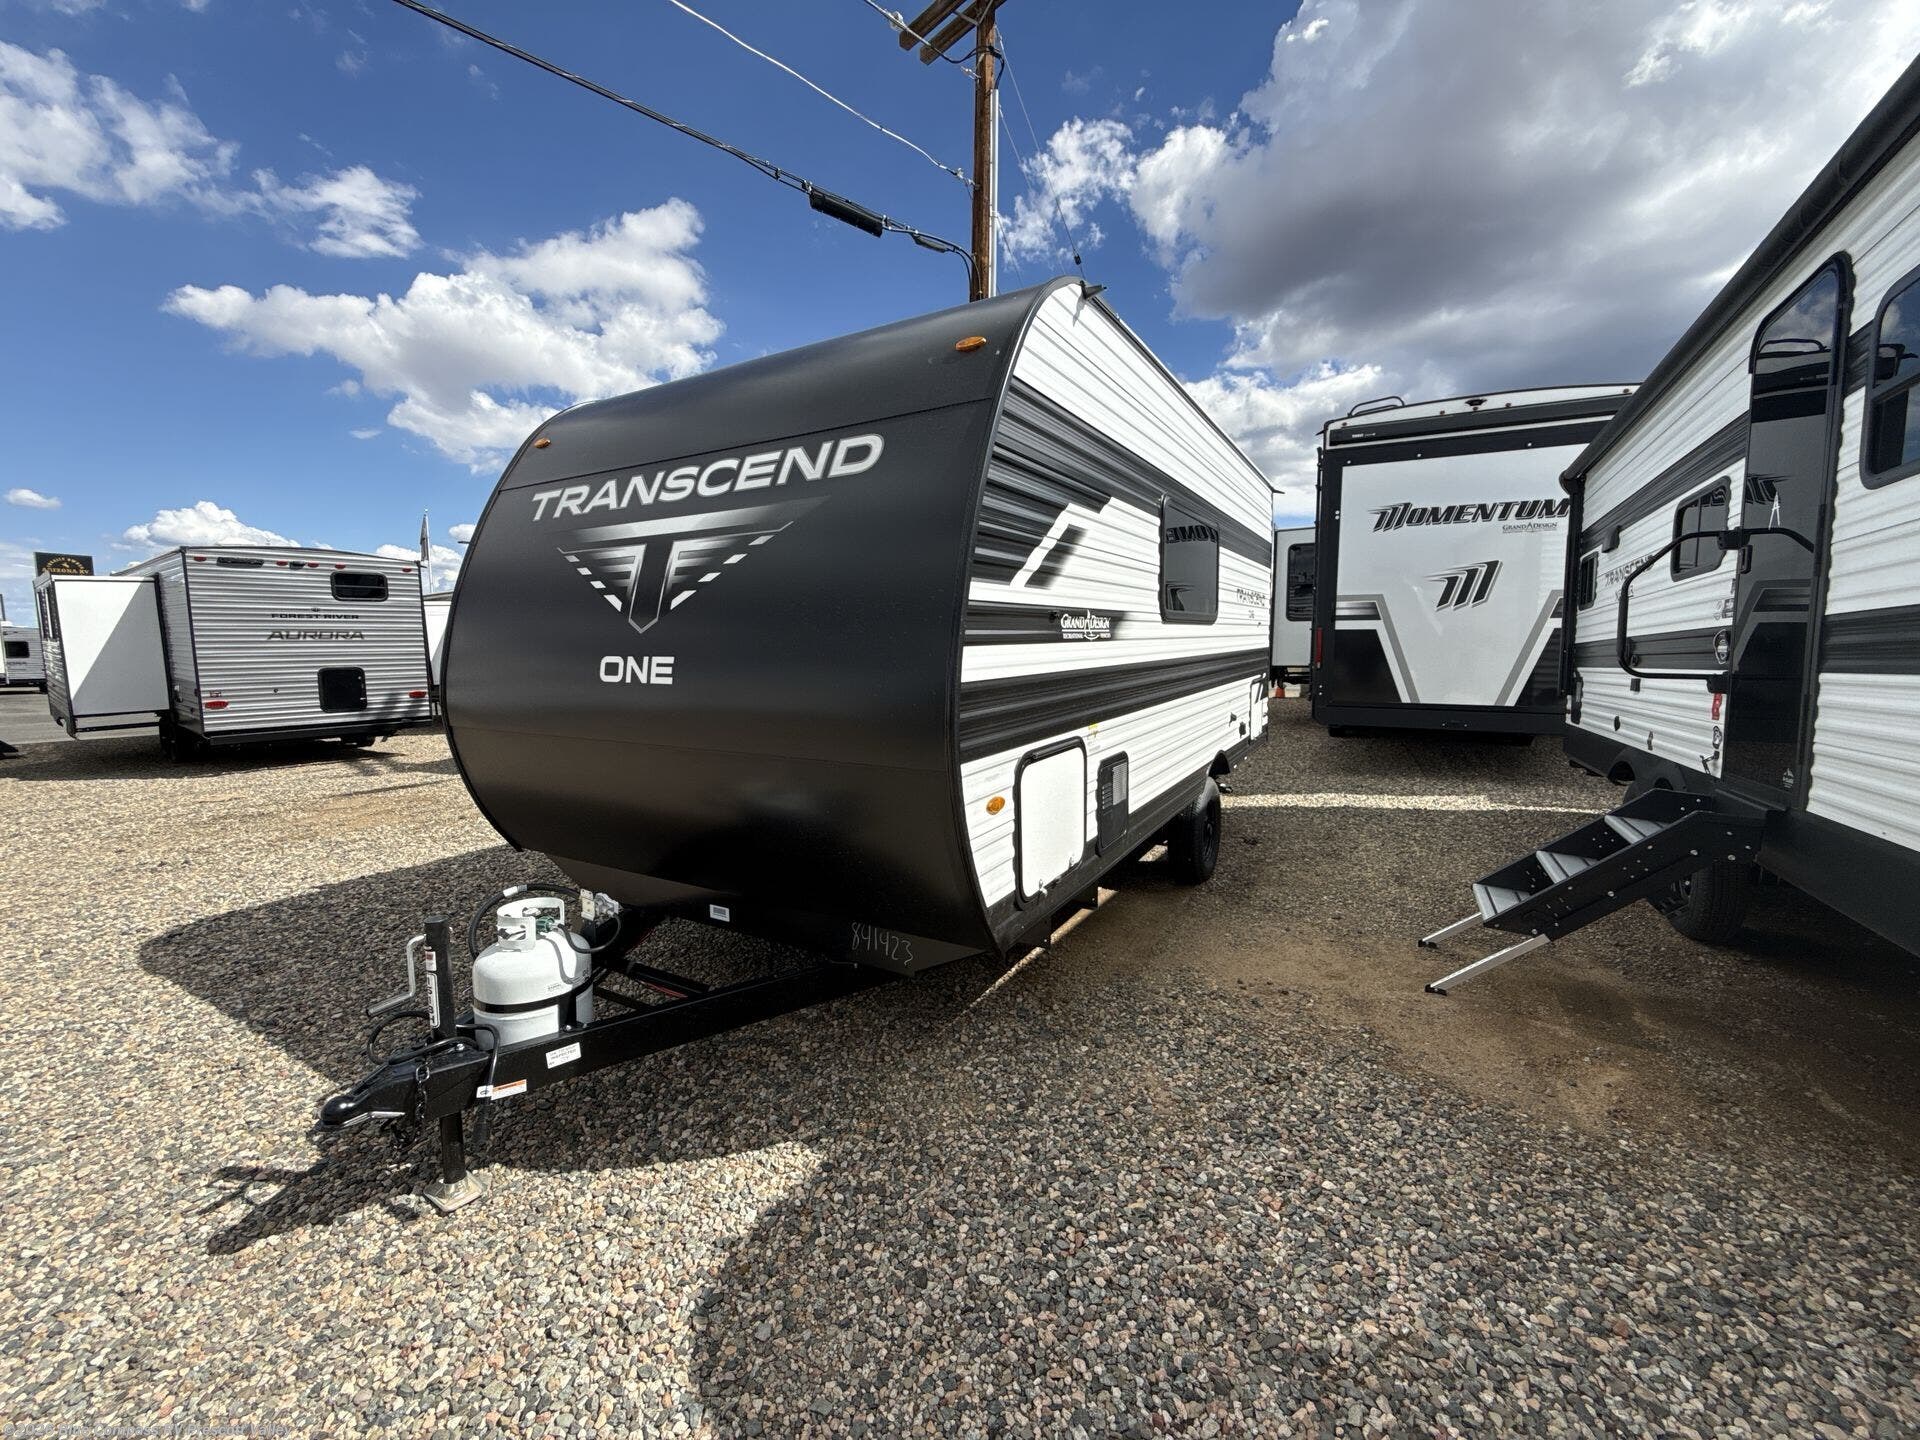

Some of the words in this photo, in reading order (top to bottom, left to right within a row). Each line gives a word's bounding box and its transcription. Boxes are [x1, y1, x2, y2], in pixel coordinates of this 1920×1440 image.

[531, 433, 885, 522] TRANSCEND
[1368, 498, 1571, 532] MOMENTUM
[267, 631, 365, 640] AURORA
[1060, 613, 1085, 629] GRAND
[1091, 614, 1111, 629] DESIGN
[599, 655, 675, 685] ONE
[851, 922, 914, 967] 841423
